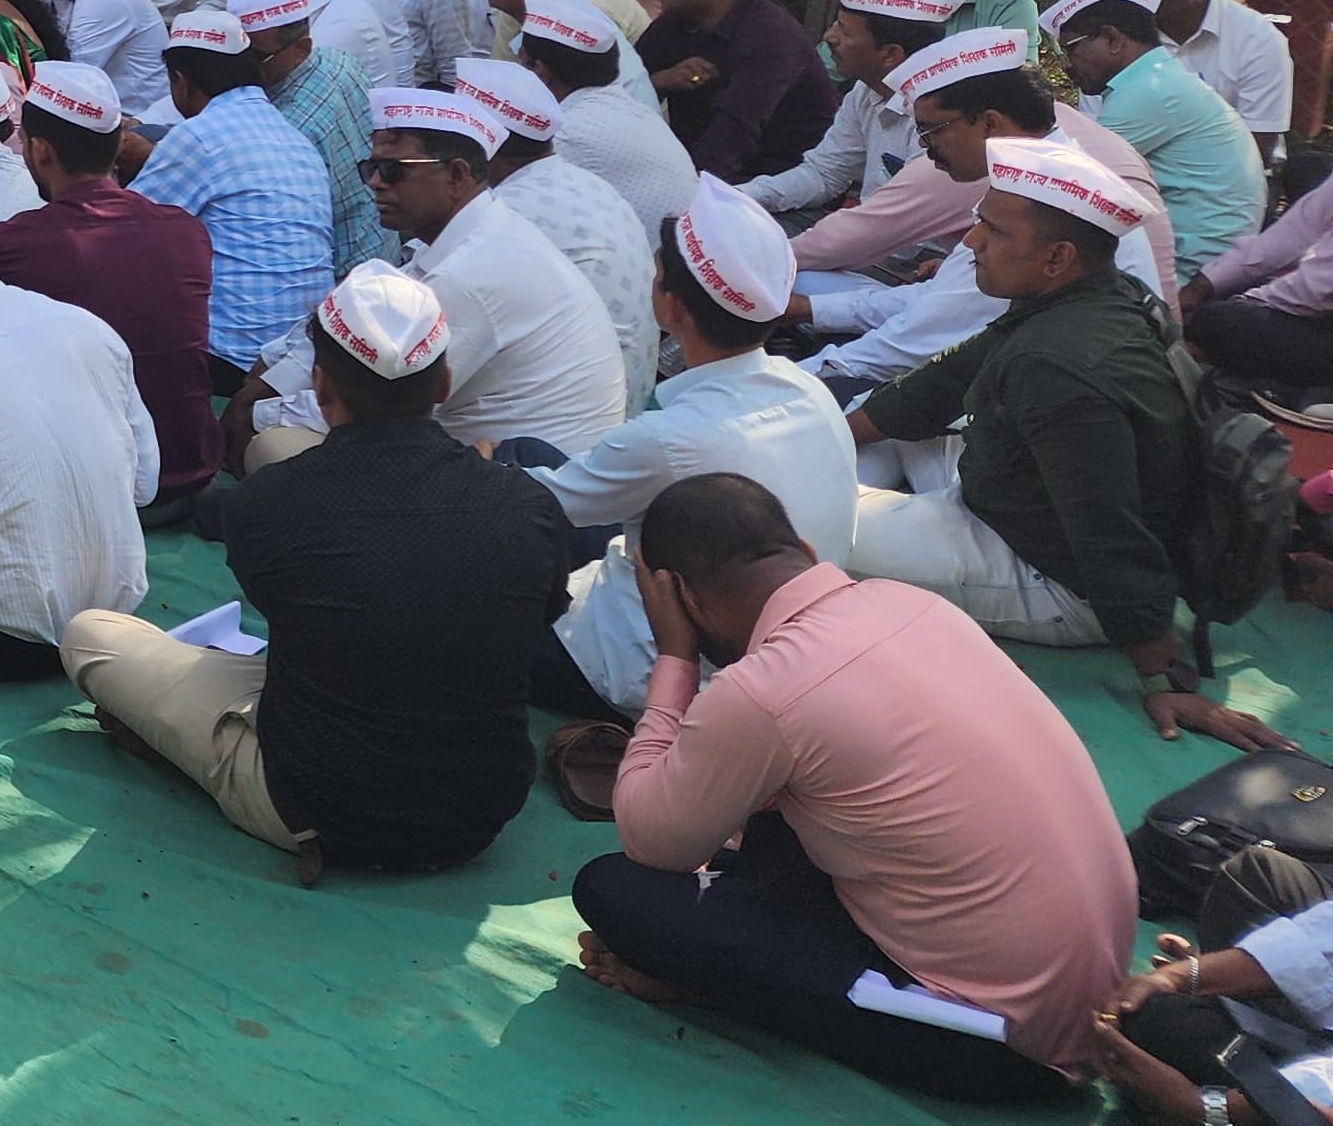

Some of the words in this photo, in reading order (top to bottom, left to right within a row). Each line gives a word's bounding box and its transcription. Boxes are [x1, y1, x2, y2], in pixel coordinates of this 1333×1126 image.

[553, 19, 574, 37] शिक्षक
[574, 30, 597, 47] समिती
[928, 56, 959, 77] प्राथमिक
[959, 48, 988, 65] शिक्षक
[989, 39, 1016, 58] समिती
[55, 89, 77, 110] शिक्षक
[77, 101, 103, 120] समिती
[384, 105, 413, 118] महाराष्ट्र
[415, 105, 434, 116] राज्य
[500, 99, 525, 122] शिक्षक
[525, 114, 550, 132] समिती
[993, 163, 1023, 183] महाराष्ट्र
[1025, 171, 1048, 186] राज्य
[1090, 189, 1118, 215] शिक्षक
[698, 259, 727, 292] शिक्षक
[722, 282, 755, 312] समिती
[329, 309, 351, 340] शिक्षक
[349, 338, 379, 365] समिती
